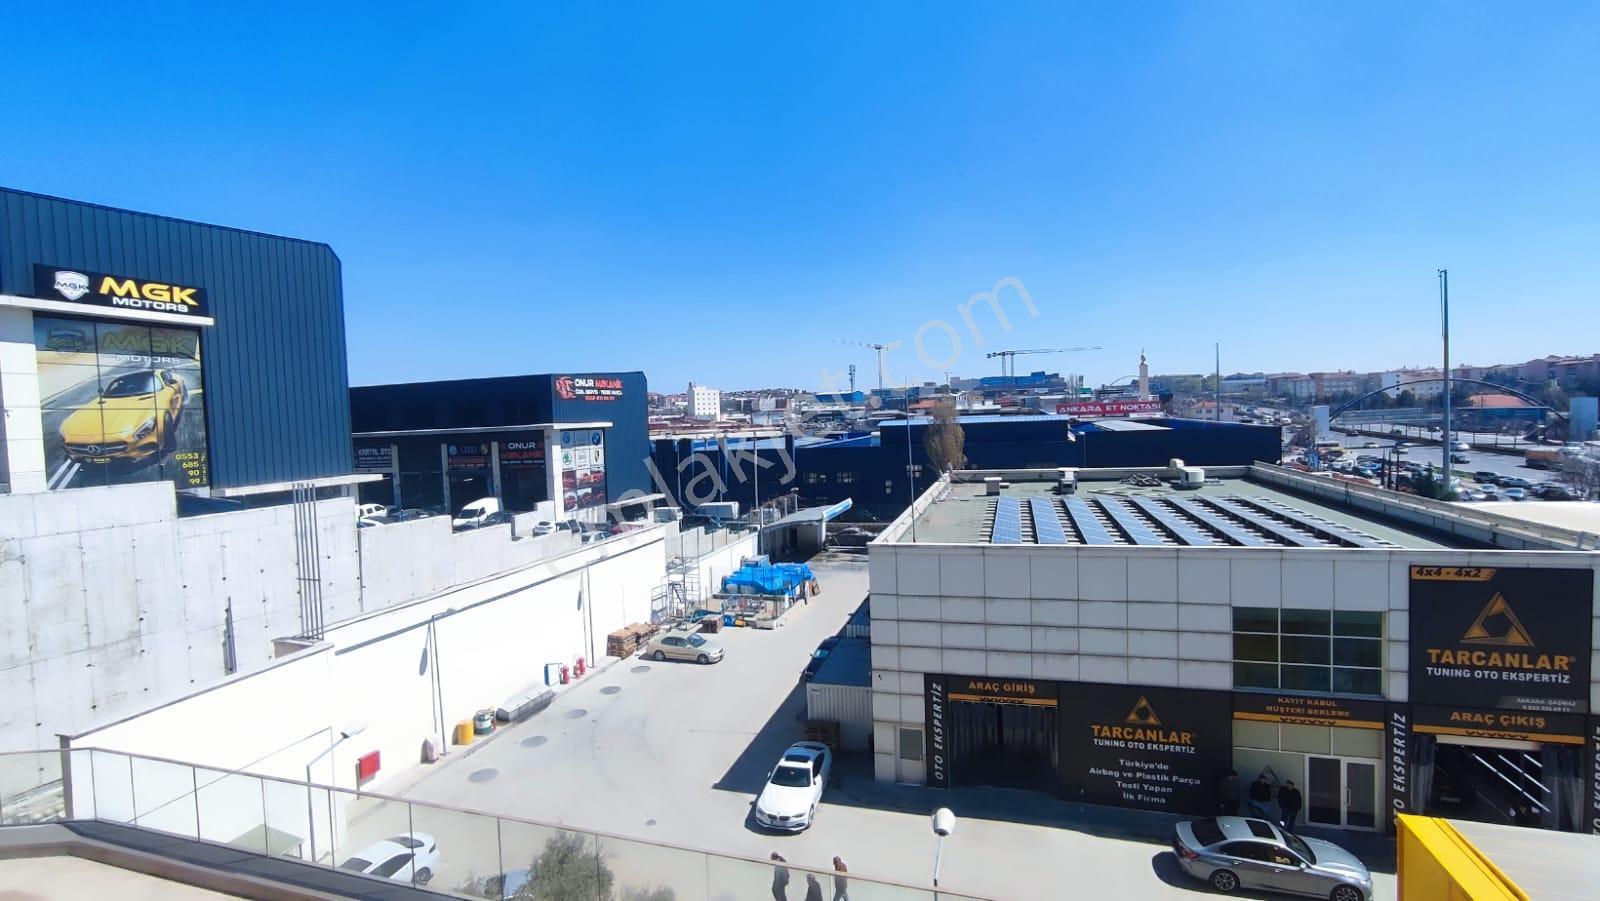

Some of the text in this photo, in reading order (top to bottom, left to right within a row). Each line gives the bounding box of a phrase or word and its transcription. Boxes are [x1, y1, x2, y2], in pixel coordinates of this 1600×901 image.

[56, 281, 87, 289] MGK
[99, 276, 199, 306] MGK
[112, 296, 188, 312] MOTORS
[574, 378, 594, 388] ONUR
[1120, 403, 1161, 411] NOKTASI
[508, 442, 536, 450] ONUR
[176, 452, 198, 460] 0553
[1416, 567, 1442, 577] 4x4
[1454, 567, 1482, 578] 4x2
[1427, 648, 1569, 671] TARCANLAR
[1425, 666, 1571, 684] TUNING OTO EKSPERTİZ
[969, 682, 1036, 694] ARAÇ GİRİŞ
[1450, 712, 1546, 728] ARAÇ ÇIKIŞ
[930, 682, 943, 780] OTO EKSPERTİZ
[1091, 724, 1192, 744] TARCANLAR
[1093, 738, 1196, 754] TUNING OTO EKSPERTİZ
[1390, 712, 1406, 792] EKSPERTİZ
[1118, 759, 1169, 770] Türkiye'de
[1089, 767, 1120, 778] Airbag
[1136, 772, 1170, 781] Plastik
[1172, 775, 1201, 785] Parça
[1116, 780, 1173, 794] Testi Yapan
[1122, 791, 1166, 804] İlk Firma
